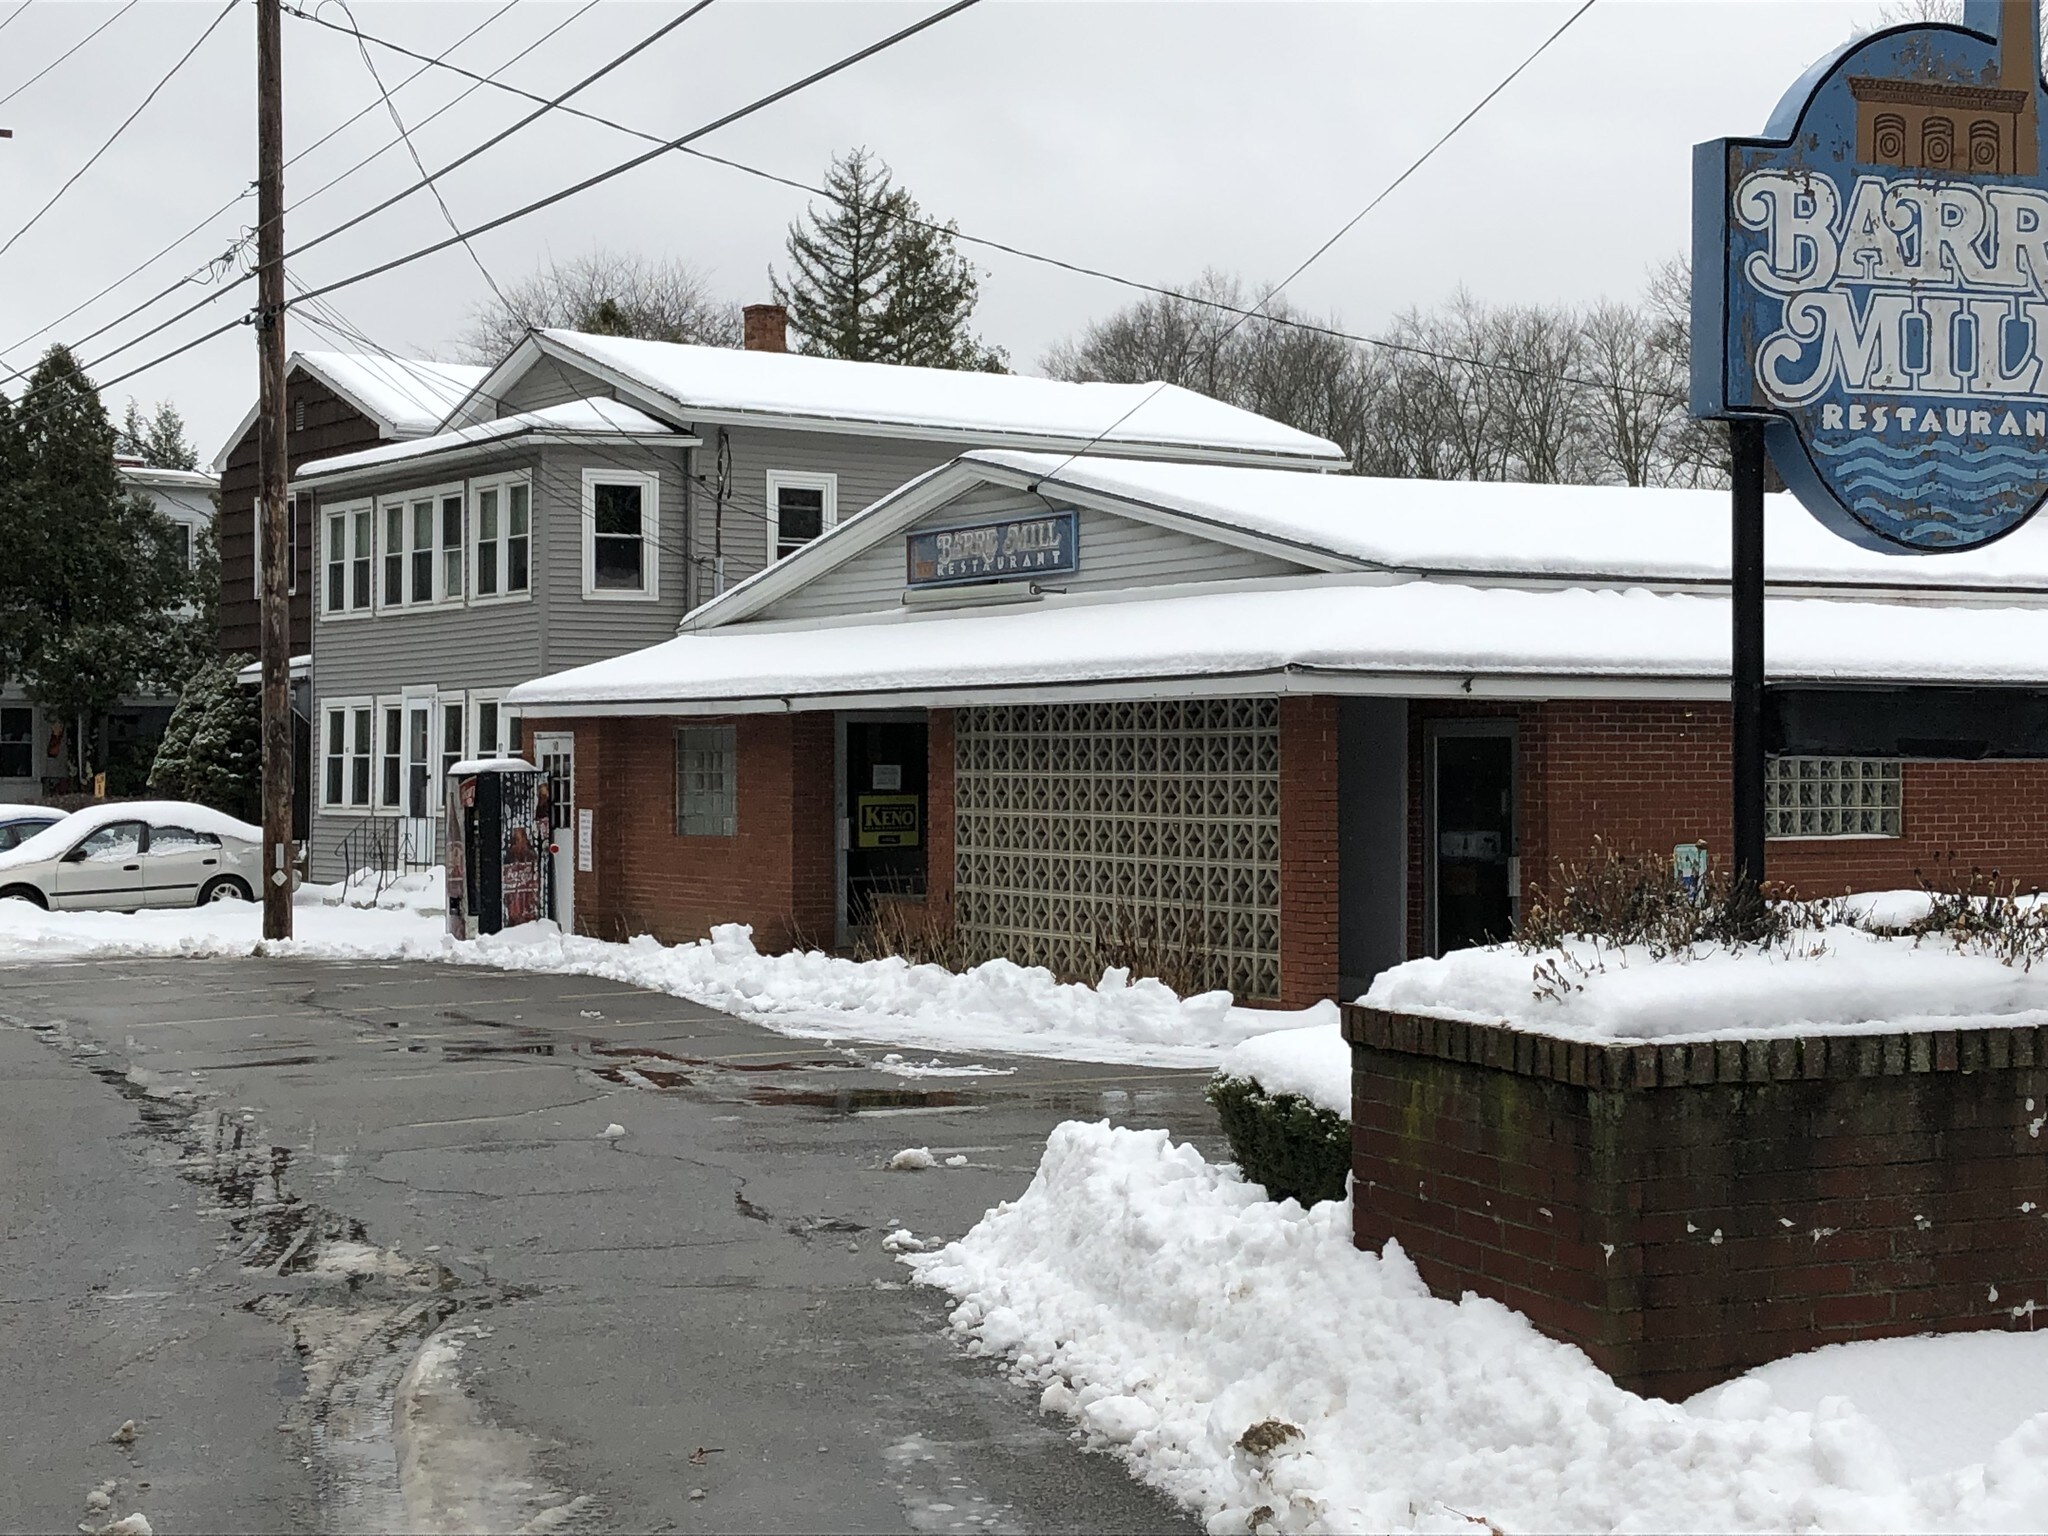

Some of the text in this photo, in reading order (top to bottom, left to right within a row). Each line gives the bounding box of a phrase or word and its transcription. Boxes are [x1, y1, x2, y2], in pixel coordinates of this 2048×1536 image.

[1733, 169, 2048, 298] BARR
[1822, 404, 2047, 436] RESTAURAN
[1004, 520, 1062, 555] MILL
[937, 550, 1060, 576] RESTAURANT
